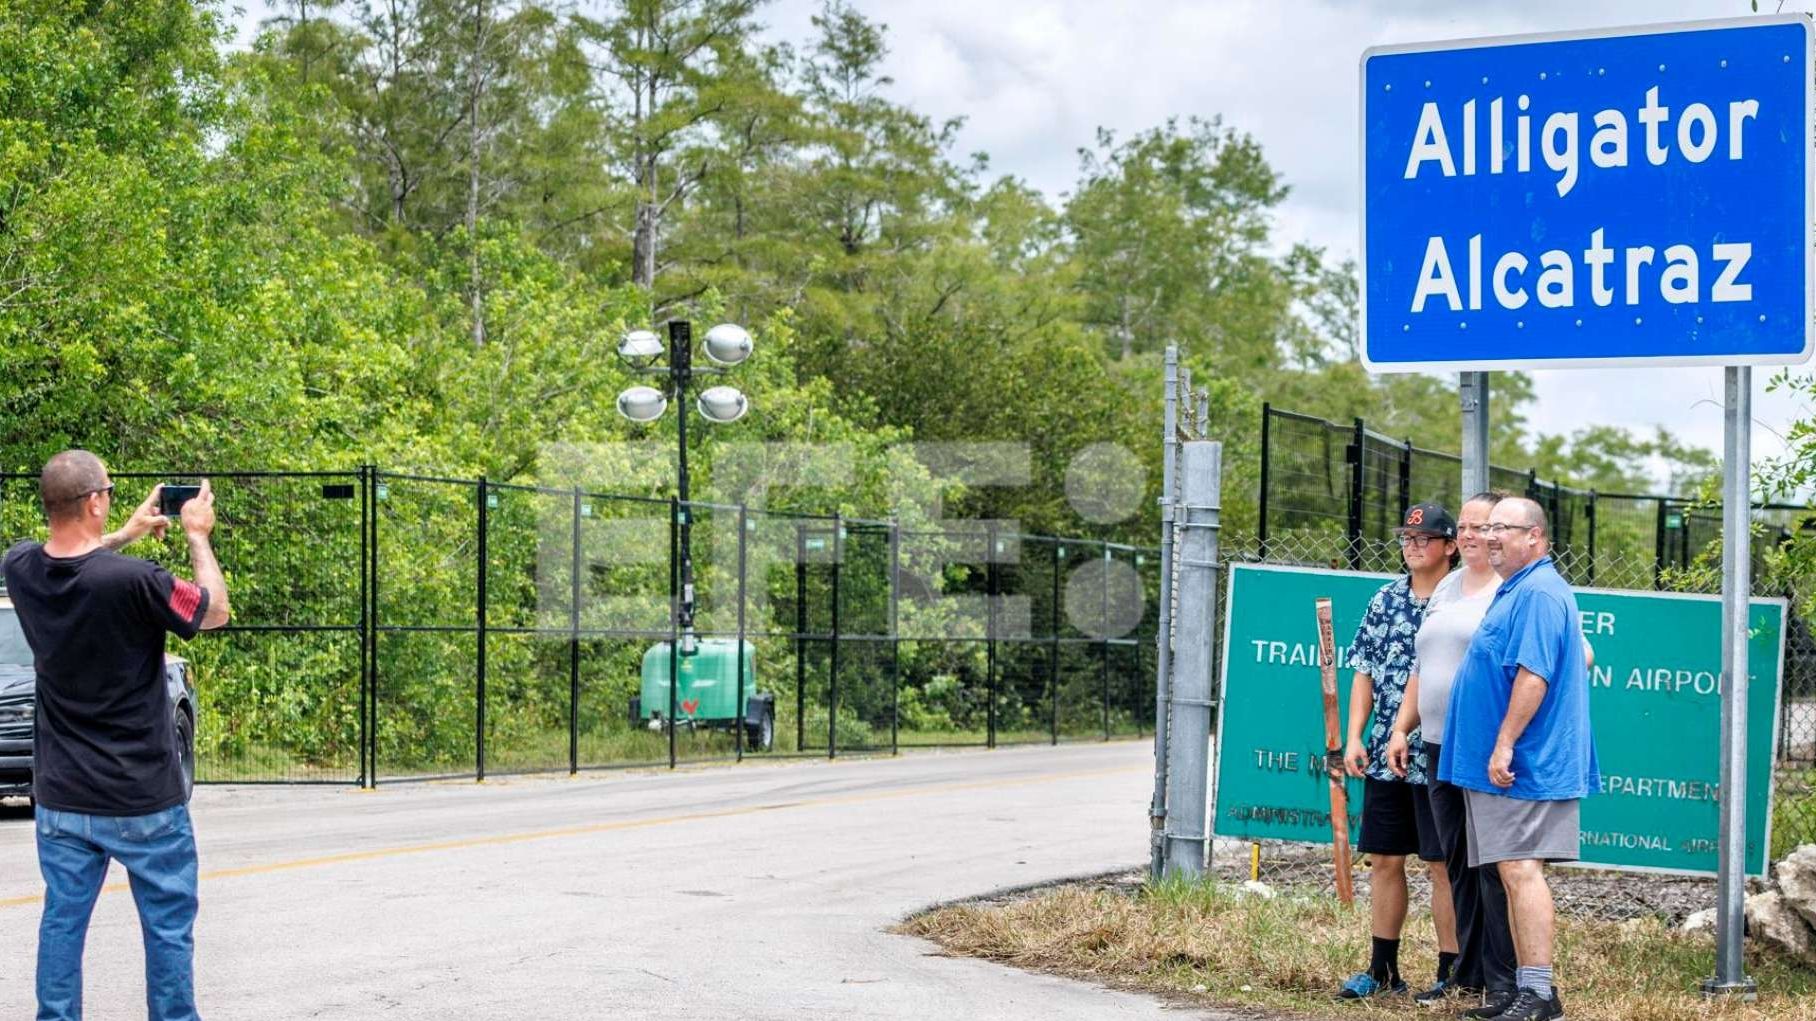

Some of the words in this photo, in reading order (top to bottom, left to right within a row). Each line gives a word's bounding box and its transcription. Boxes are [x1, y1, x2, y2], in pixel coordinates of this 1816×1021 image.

[1403, 85, 1760, 199] Alligator
[1410, 227, 1753, 313] Alcatraz
[1406, 508, 1425, 525] B
[1578, 611, 1616, 635] ER
[1251, 639, 1351, 669] TRAII
[1626, 666, 1756, 695] AIRPO
[1255, 749, 1298, 771] THE
[1599, 775, 1721, 801] EPARTMEN
[1578, 830, 1672, 851] RNATIONAL
